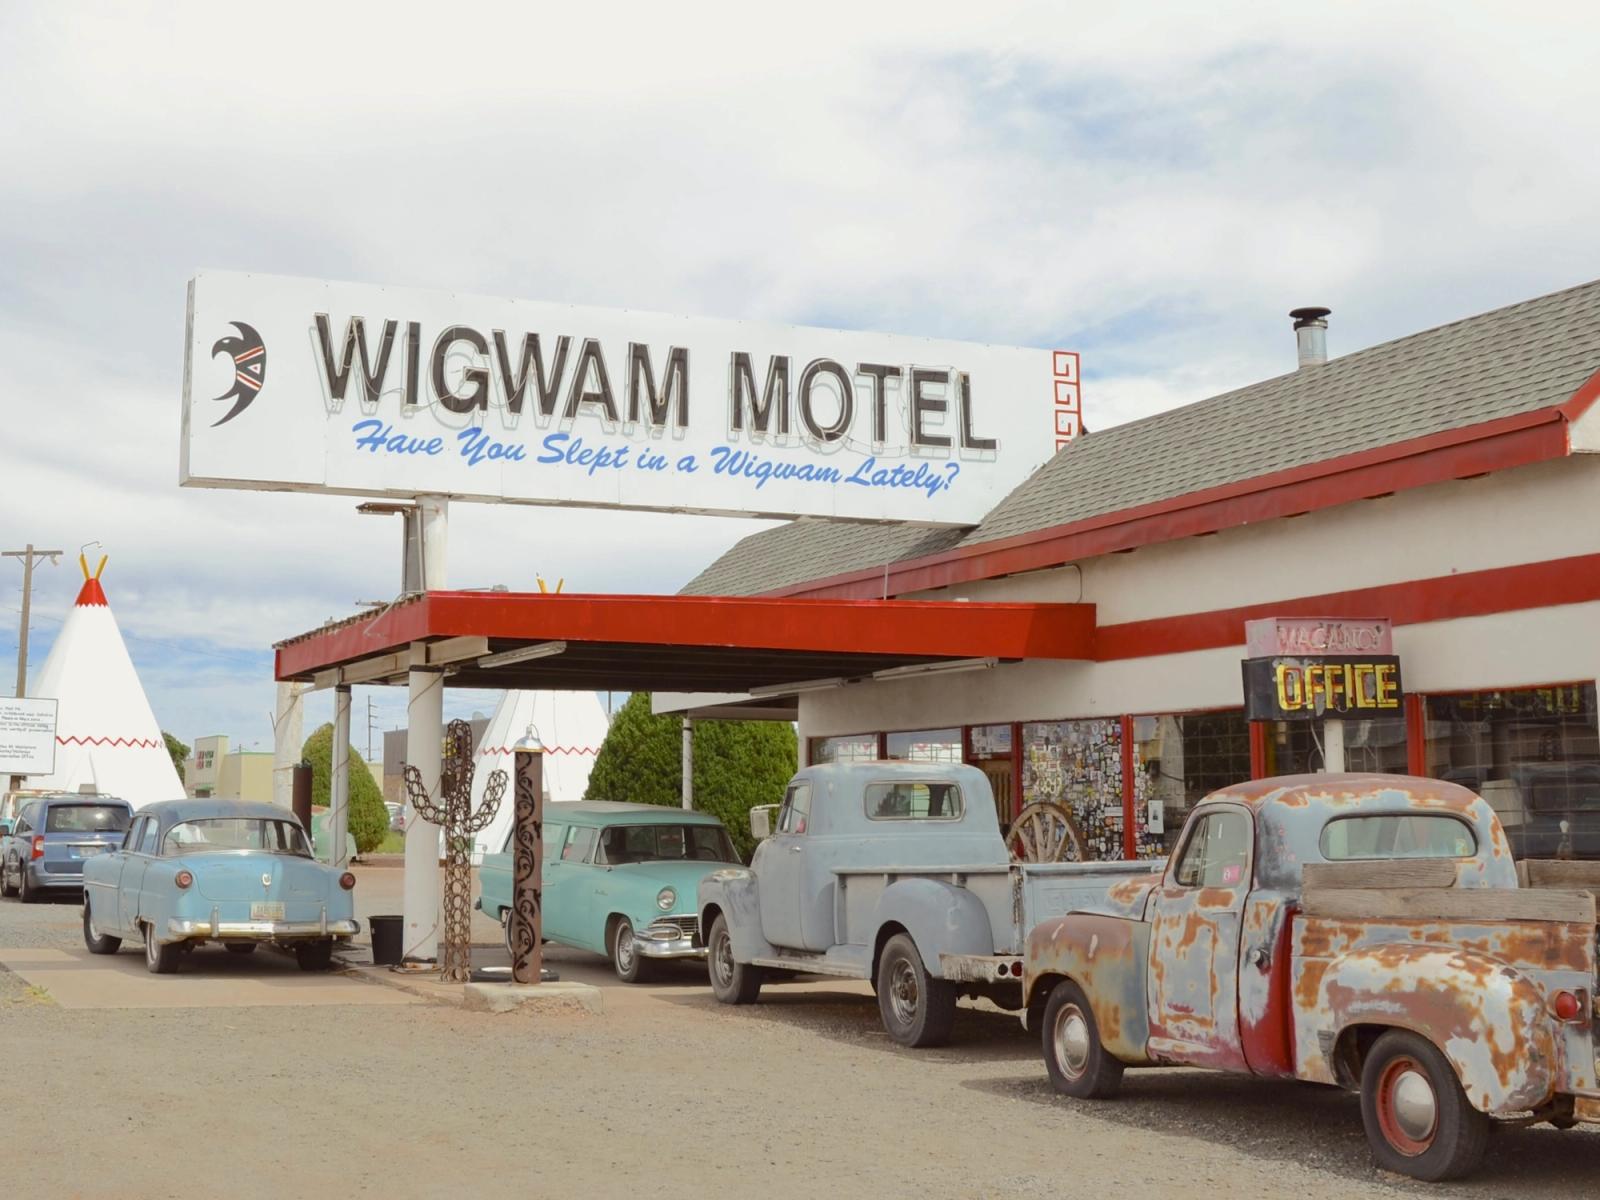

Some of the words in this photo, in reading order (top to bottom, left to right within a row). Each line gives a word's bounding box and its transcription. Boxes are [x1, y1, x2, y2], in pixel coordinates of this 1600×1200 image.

[313, 312, 692, 428] WIGWAM
[731, 350, 1000, 453] MOTEL
[353, 419, 443, 456] Have
[457, 426, 526, 465] You
[537, 433, 630, 475] Slept
[638, 446, 668, 473] in
[677, 455, 698, 474] a
[710, 446, 842, 490] Wigwam
[846, 455, 961, 498] Lately?
[1275, 663, 1399, 711] OFFICE
